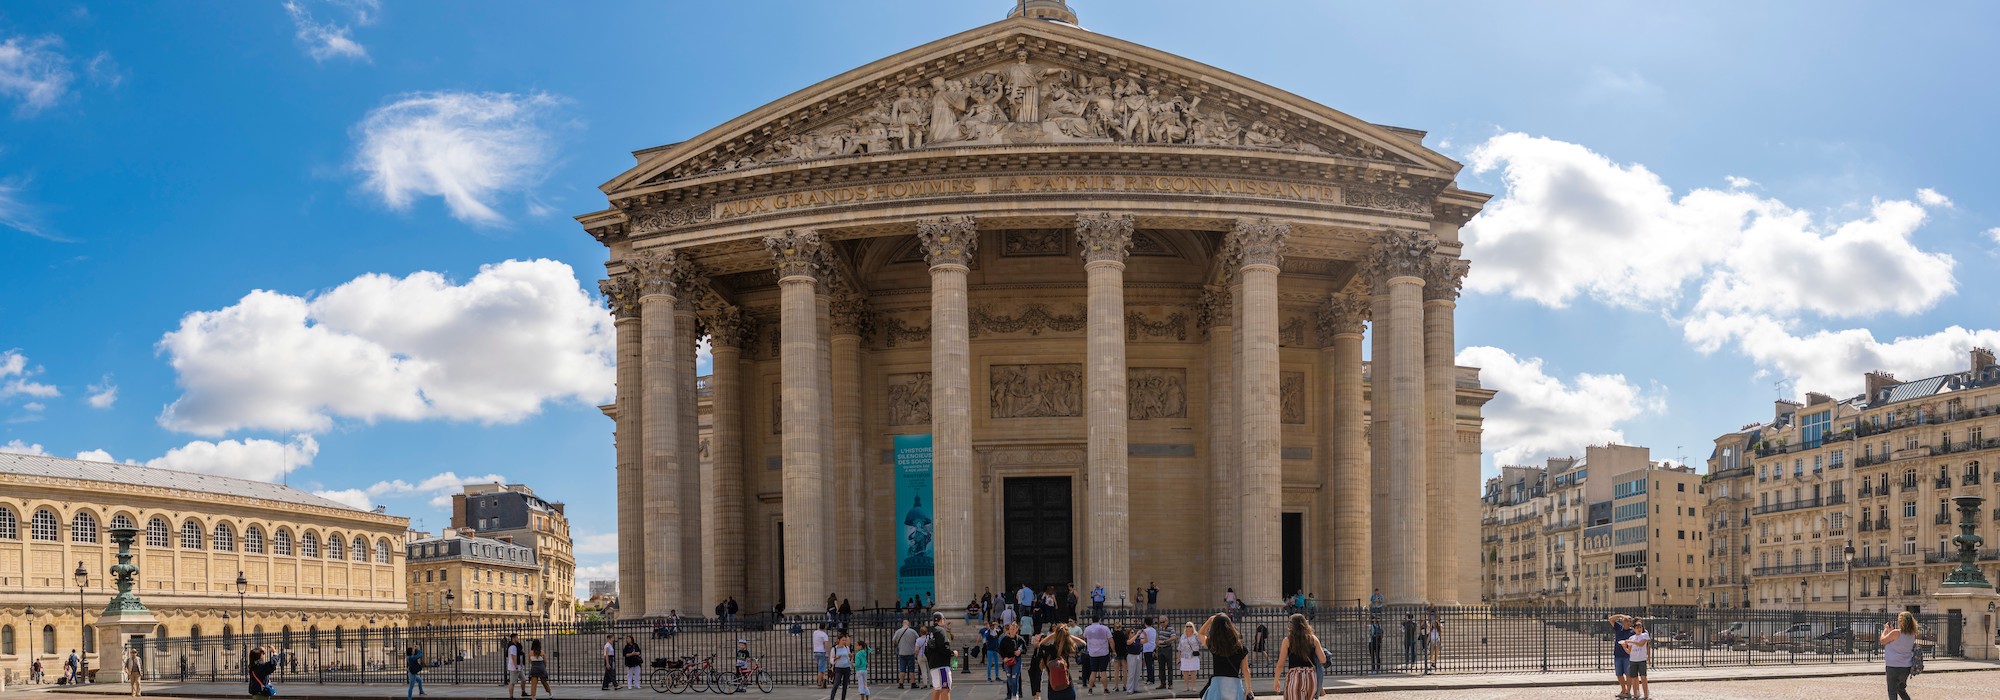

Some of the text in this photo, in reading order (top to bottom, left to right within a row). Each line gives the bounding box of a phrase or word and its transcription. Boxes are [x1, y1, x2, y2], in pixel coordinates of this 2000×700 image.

[721, 175, 1335, 215] AUX GRANDS HOMMES LA PATRIE RECONNAISSANTE
